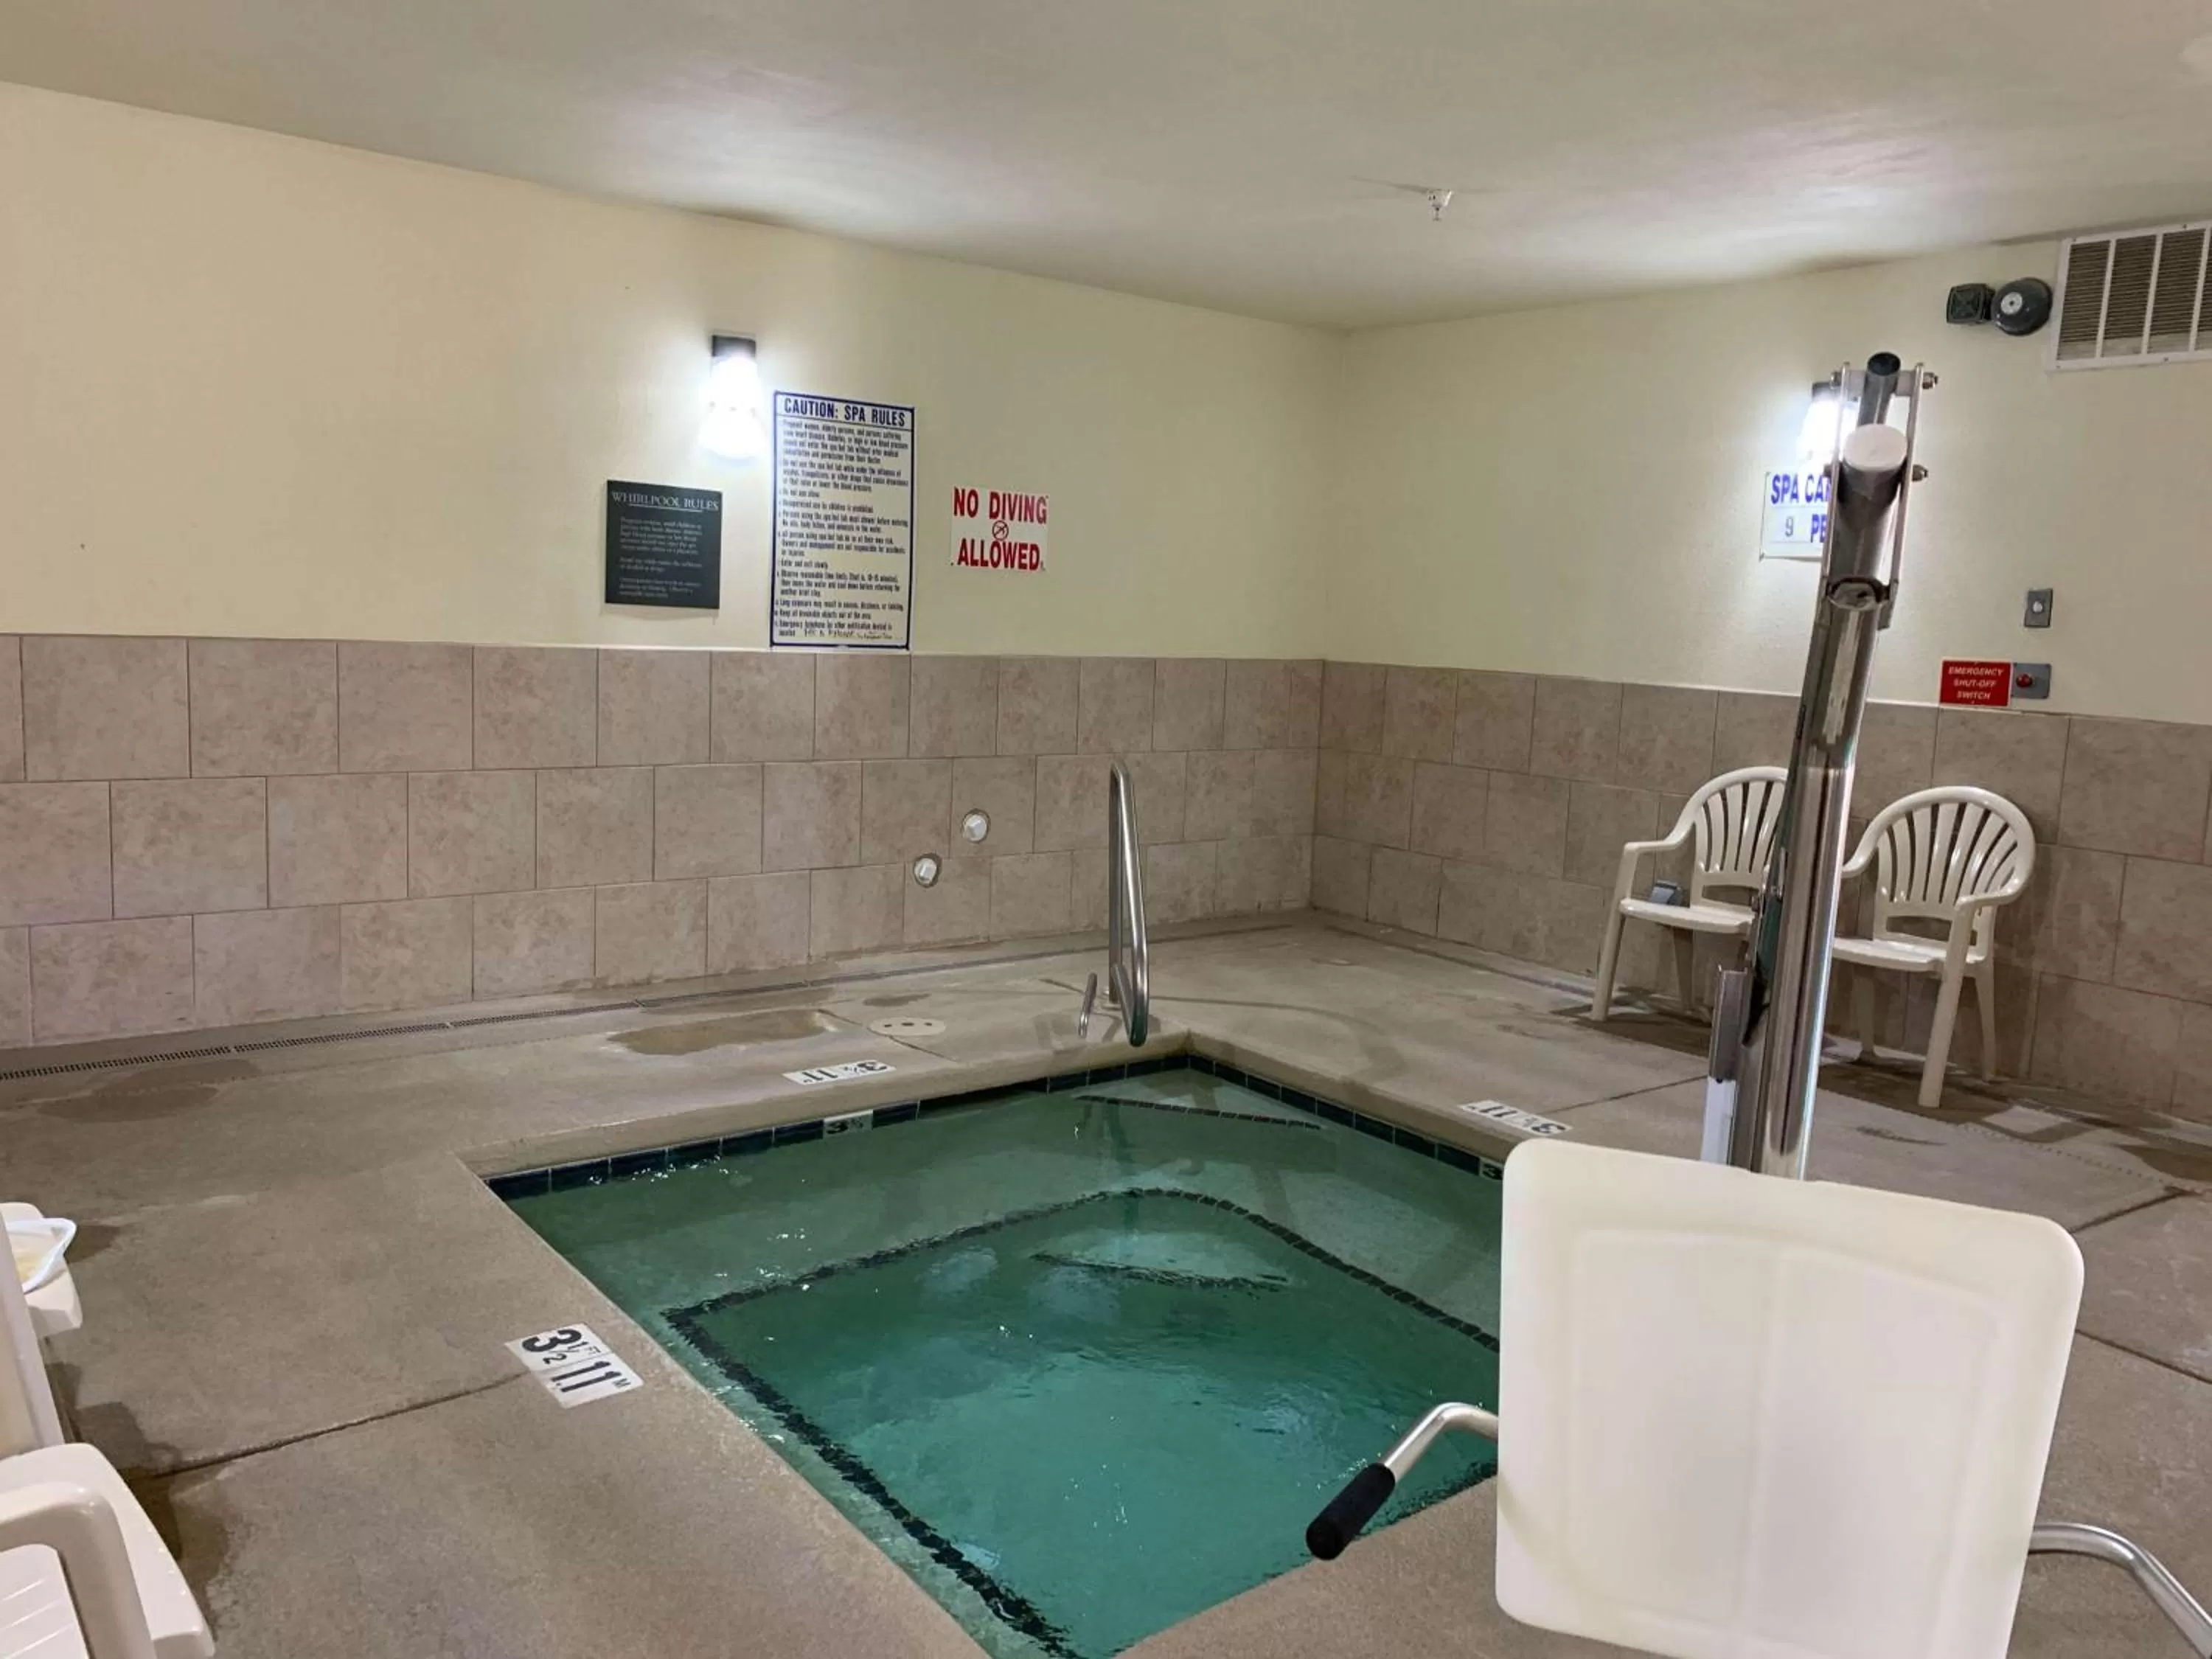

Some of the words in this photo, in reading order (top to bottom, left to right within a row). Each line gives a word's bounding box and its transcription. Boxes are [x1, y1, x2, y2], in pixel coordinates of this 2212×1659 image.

[784, 397, 838, 420] CAUTION:
[844, 405, 866, 422] SPA
[872, 408, 905, 427] RULES
[1771, 474, 1799, 504] SPA
[611, 491, 679, 507] WHIRLPOOL
[684, 498, 720, 511] RULES
[954, 487, 979, 518] NO
[989, 491, 1047, 524] DIVING
[1784, 515, 1795, 538] 9
[957, 538, 1040, 571] ALLOWED
[1948, 666, 2005, 676] EMERGENCY
[1954, 678, 1997, 688] SHUT-OFF
[1957, 691, 1991, 700] SWITCH
